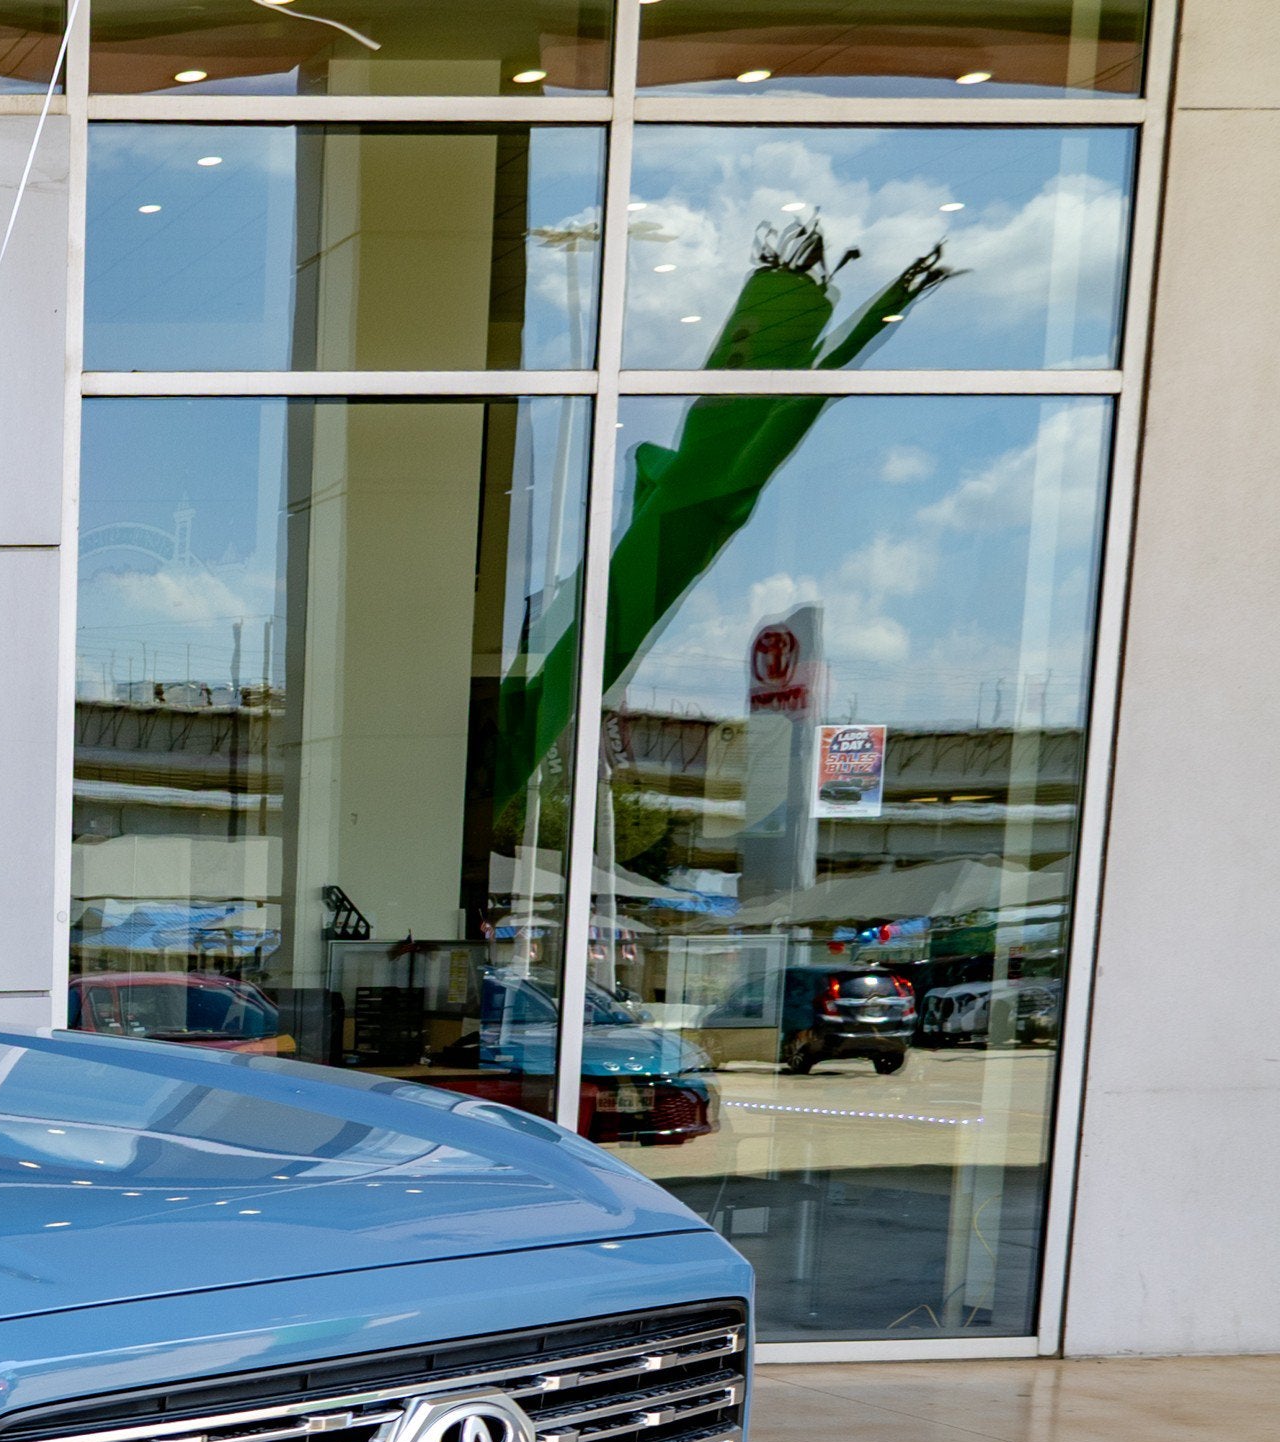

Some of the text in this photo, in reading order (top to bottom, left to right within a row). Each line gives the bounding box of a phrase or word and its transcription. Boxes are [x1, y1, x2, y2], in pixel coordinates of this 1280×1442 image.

[838, 731, 869, 742] LABOR
[841, 740, 864, 751] DAY
[827, 752, 878, 763] SALES
[824, 763, 873, 774] BLITZ
